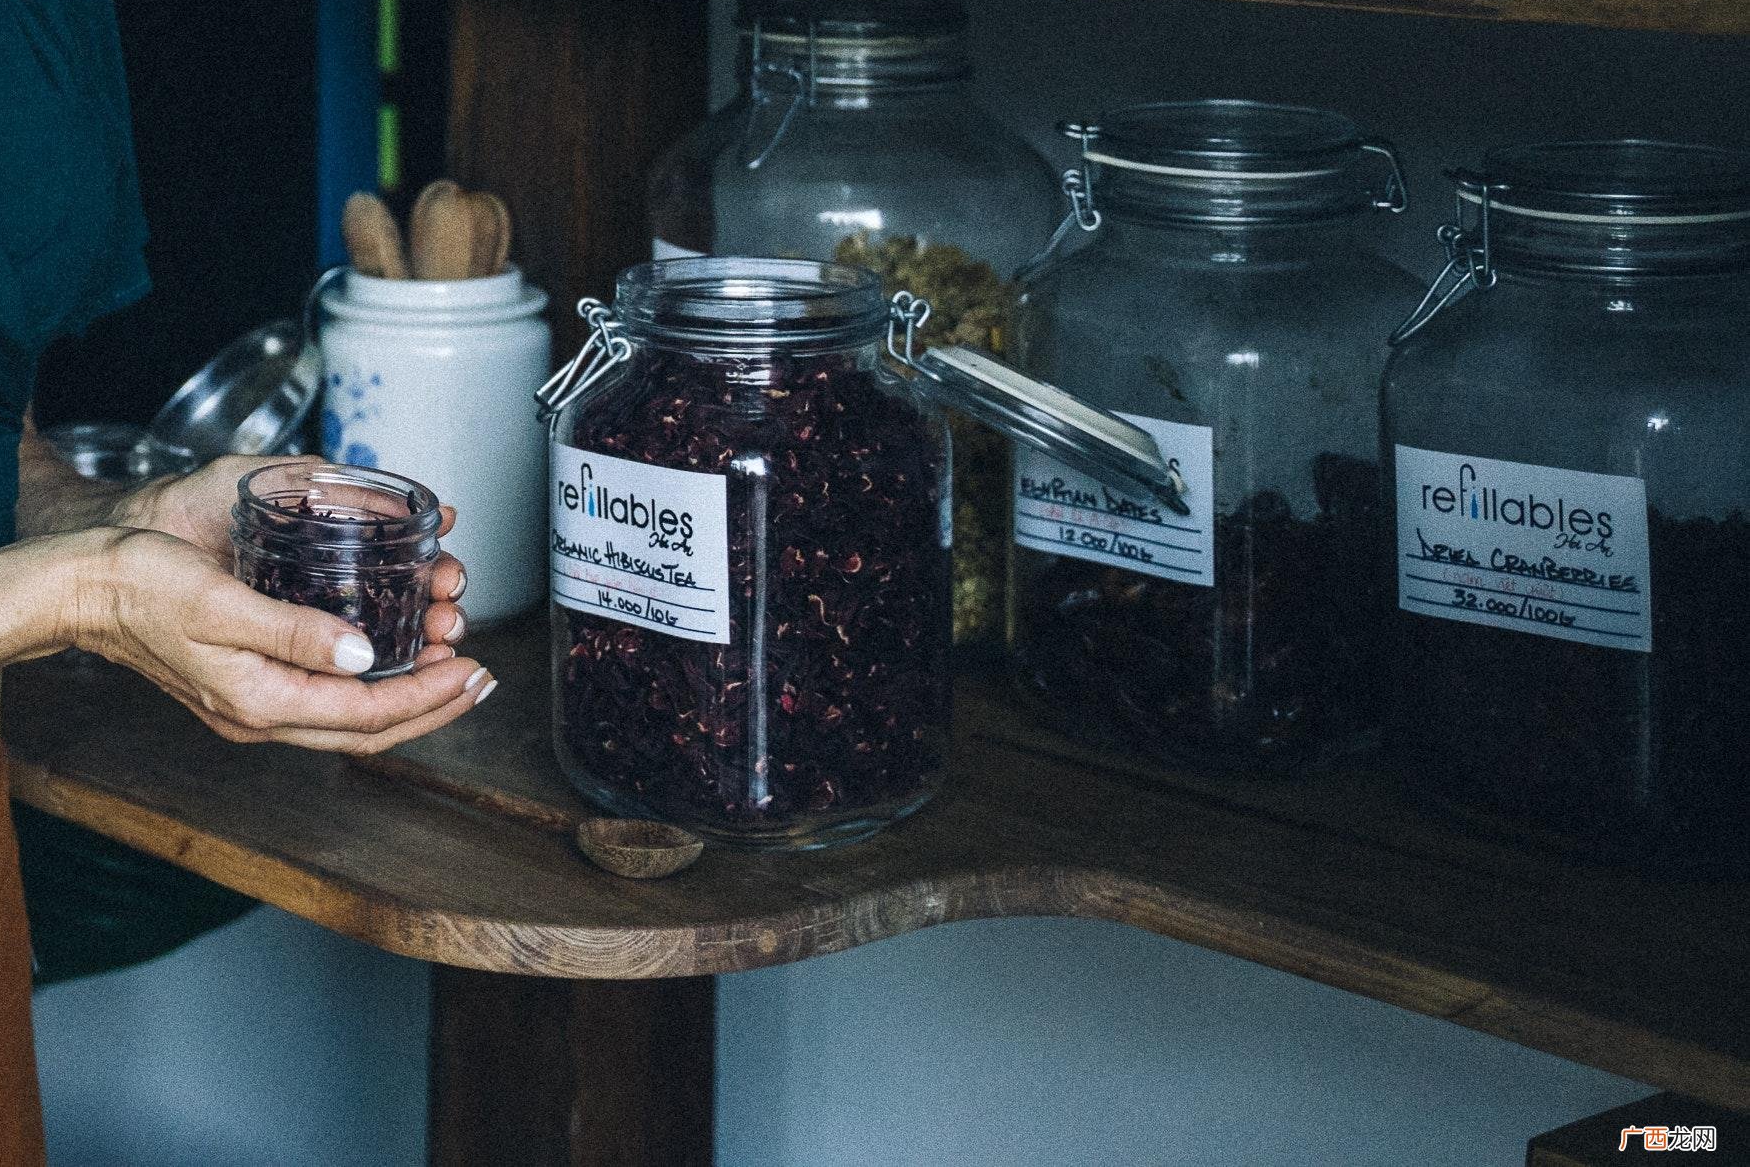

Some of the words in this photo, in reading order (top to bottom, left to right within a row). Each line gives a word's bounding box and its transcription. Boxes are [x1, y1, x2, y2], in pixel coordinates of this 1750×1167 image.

[558, 462, 693, 539] refillables
[1422, 463, 1613, 539] refillables
[661, 563, 697, 588] TEA
